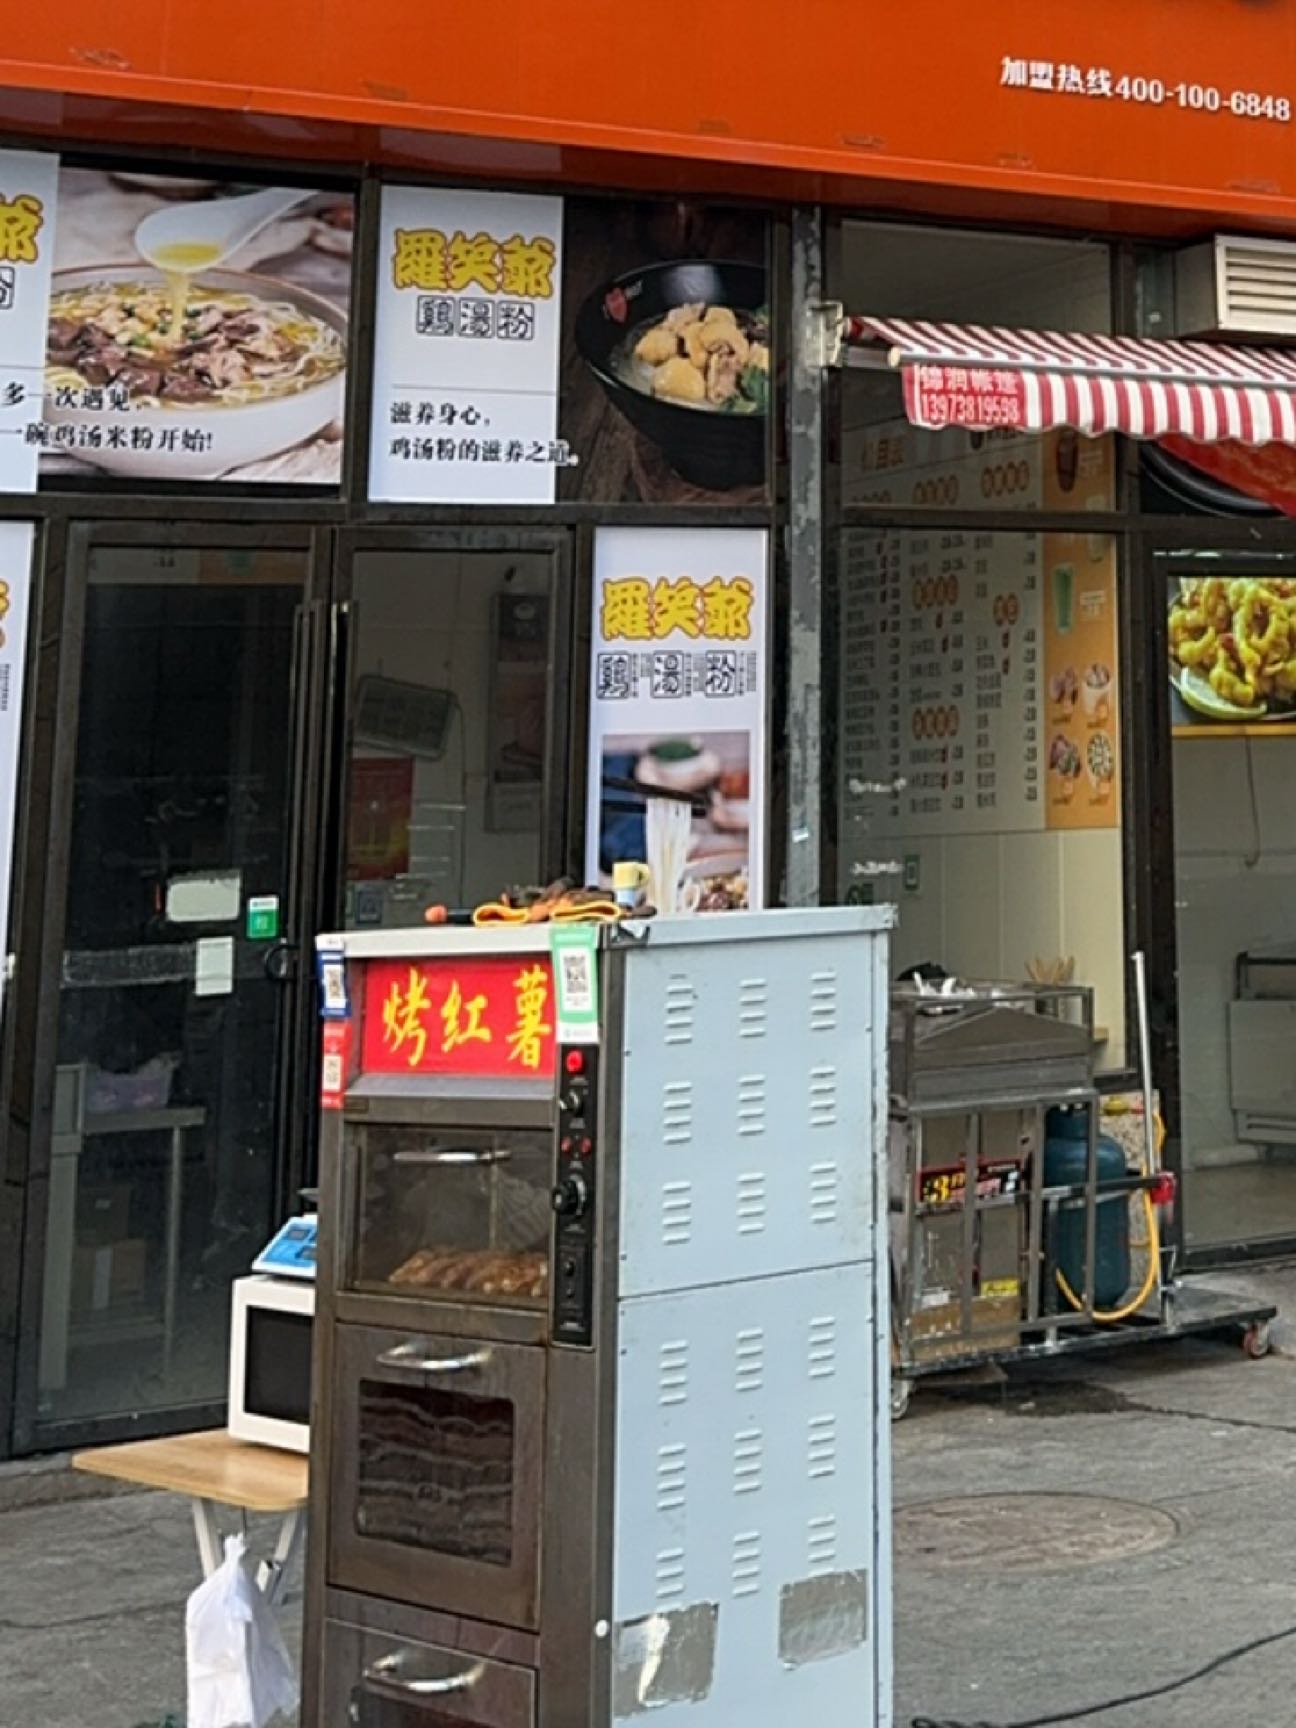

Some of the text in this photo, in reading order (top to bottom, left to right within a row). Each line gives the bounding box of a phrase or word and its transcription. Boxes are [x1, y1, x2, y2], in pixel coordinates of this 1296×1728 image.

[1000, 56, 1292, 123] 加盟热线400-100-6848
[382, 963, 551, 1069] 烤红薯
